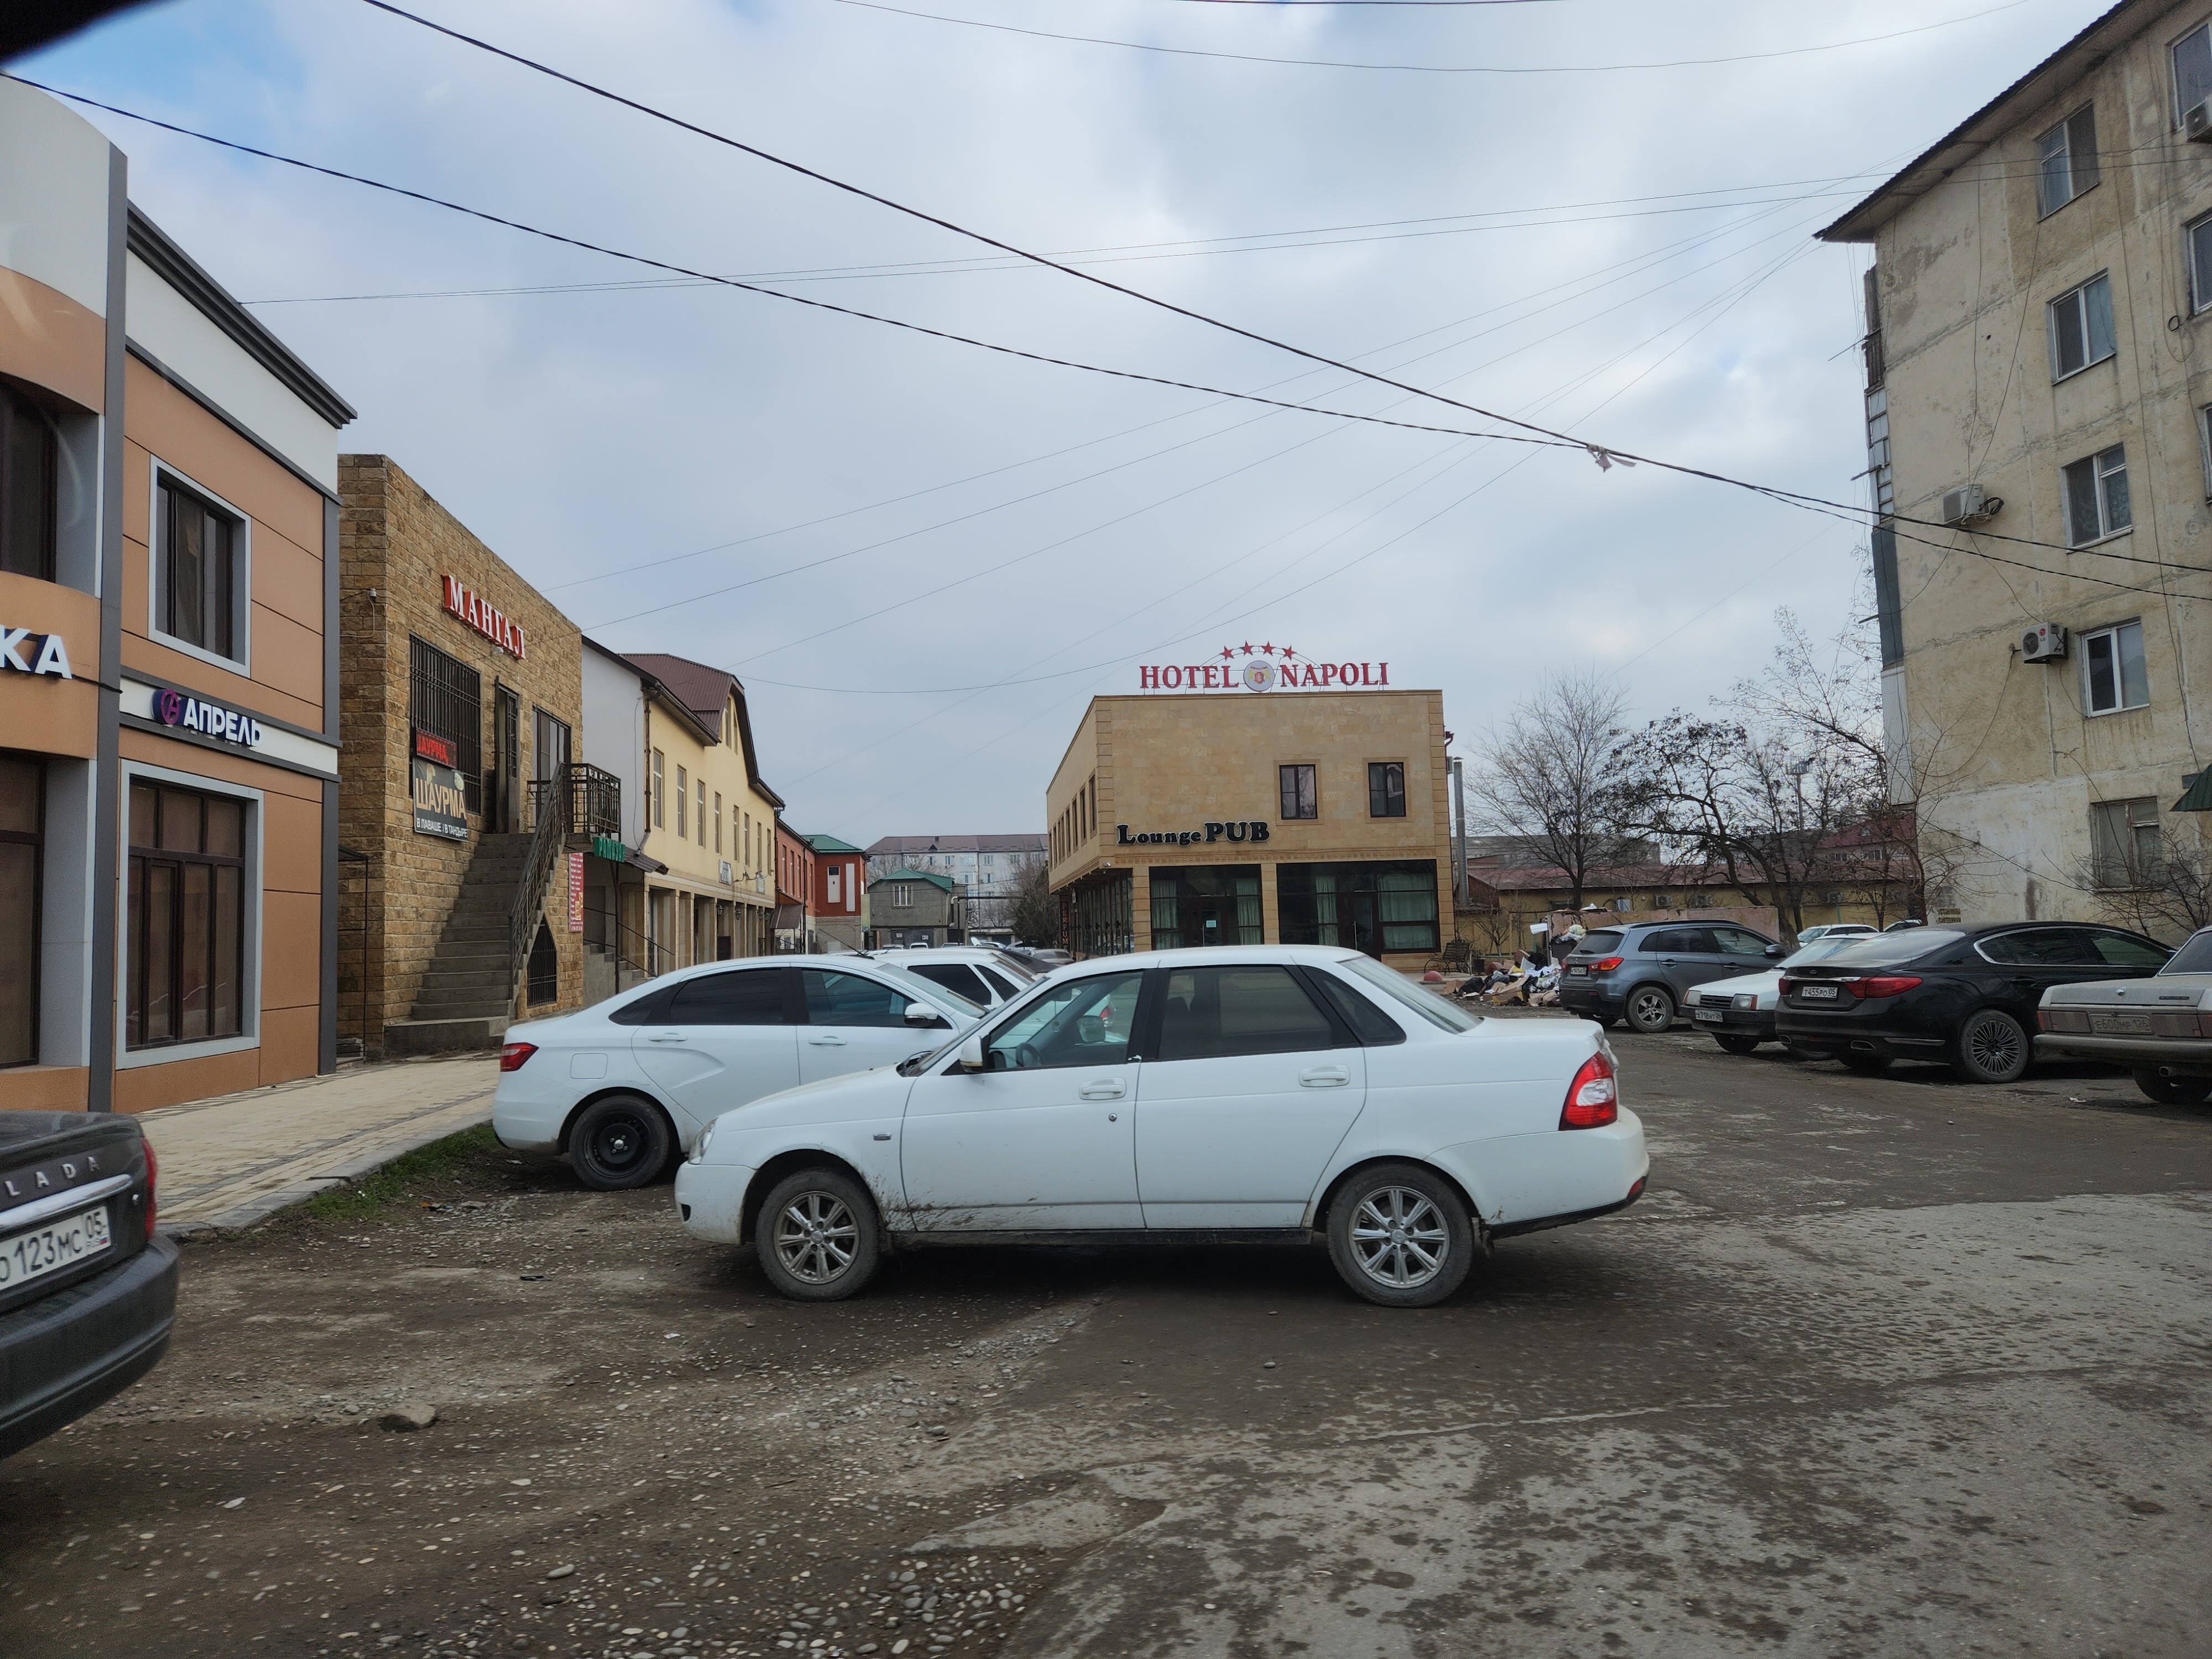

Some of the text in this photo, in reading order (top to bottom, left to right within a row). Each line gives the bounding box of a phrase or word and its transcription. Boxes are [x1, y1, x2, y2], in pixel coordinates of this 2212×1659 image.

[448, 575, 526, 659] МАНГАЛ
[1140, 662, 1389, 689] HOTEL NAPOLI
[184, 698, 263, 747] АПРЕЛЬ
[415, 778, 467, 820] ШАУРМА
[416, 818, 420, 828] В
[421, 819, 442, 832] ЛАВАШЕ
[444, 824, 448, 833] В
[1116, 821, 1270, 847] Lounge PUB
[5, 1156, 100, 1196] LADA
